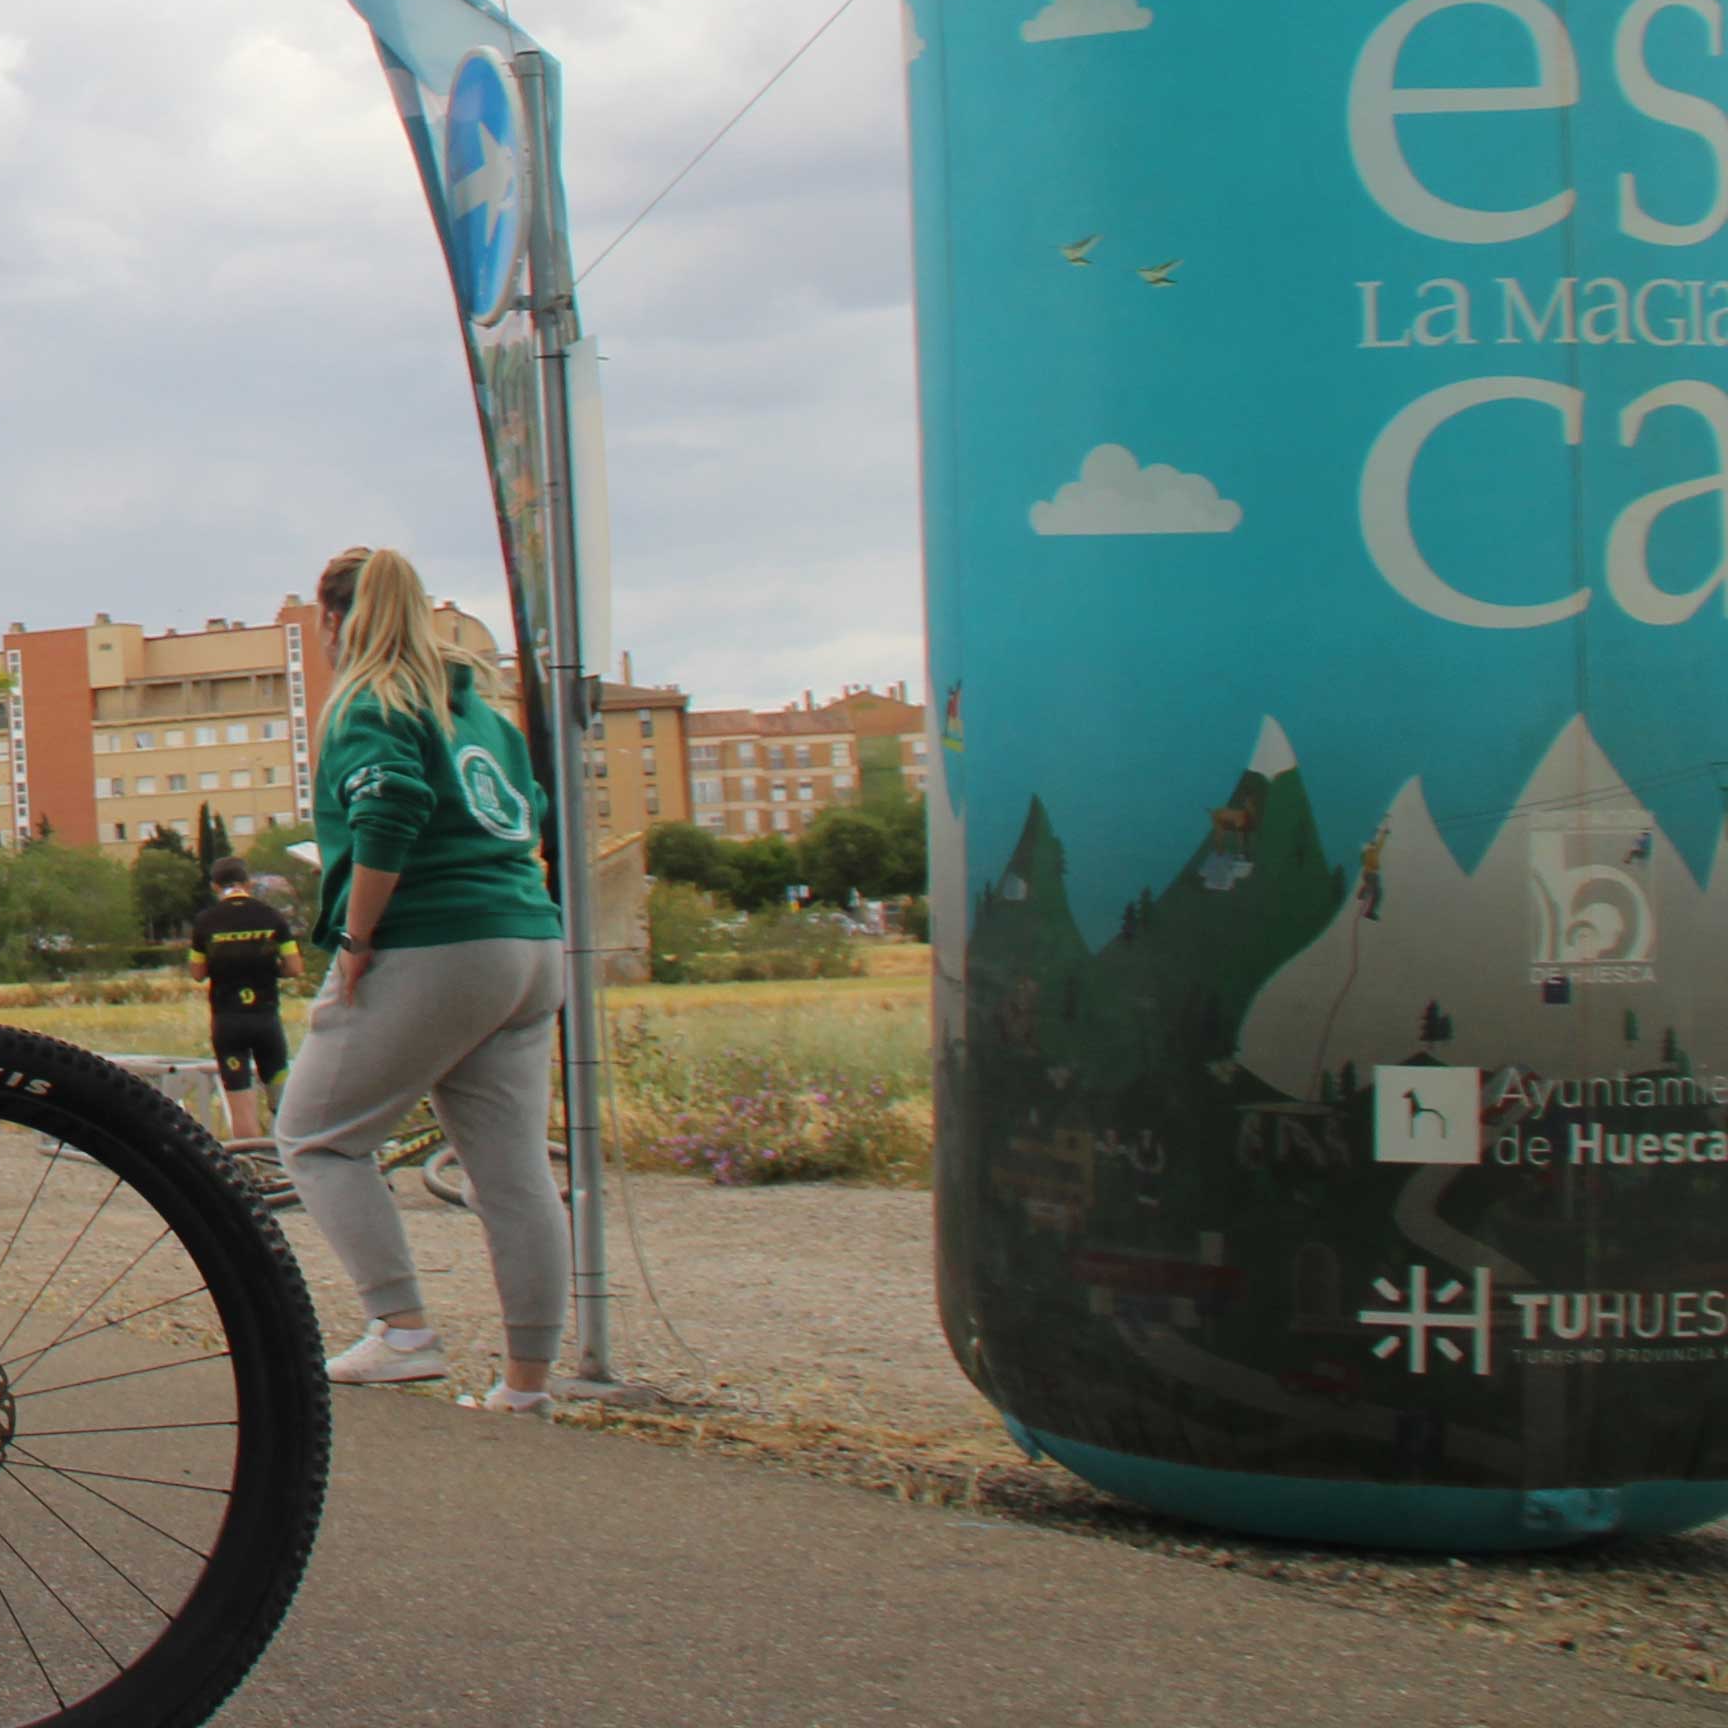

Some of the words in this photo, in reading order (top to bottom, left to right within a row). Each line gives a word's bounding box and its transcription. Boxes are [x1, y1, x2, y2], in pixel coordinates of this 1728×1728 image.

[1356, 276, 1477, 350] La
[1497, 1067, 1728, 1121] Ayuntamie
[1495, 1124, 1553, 1165] de
[1567, 1122, 1728, 1165] Huesca
